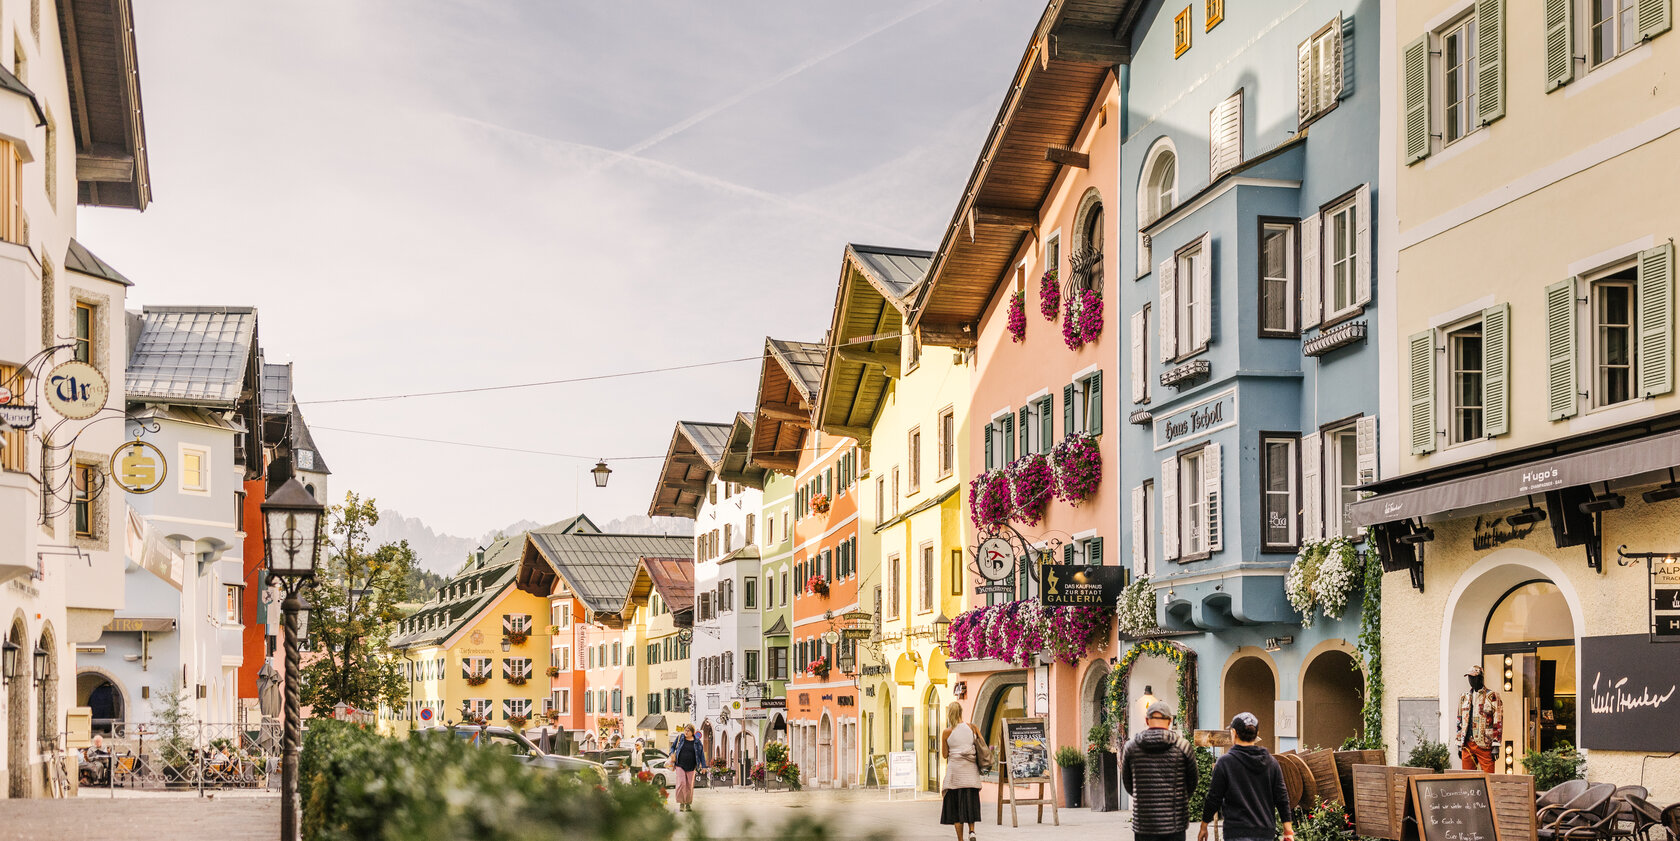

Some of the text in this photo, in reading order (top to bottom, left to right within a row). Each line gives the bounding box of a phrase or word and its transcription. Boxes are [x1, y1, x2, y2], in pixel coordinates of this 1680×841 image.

[1190, 401, 1223, 433] Tscholl
[1522, 466, 1558, 482] H'ugo's
[845, 630, 870, 639] Apotheke
[1012, 733, 1042, 741] TERRASSE
